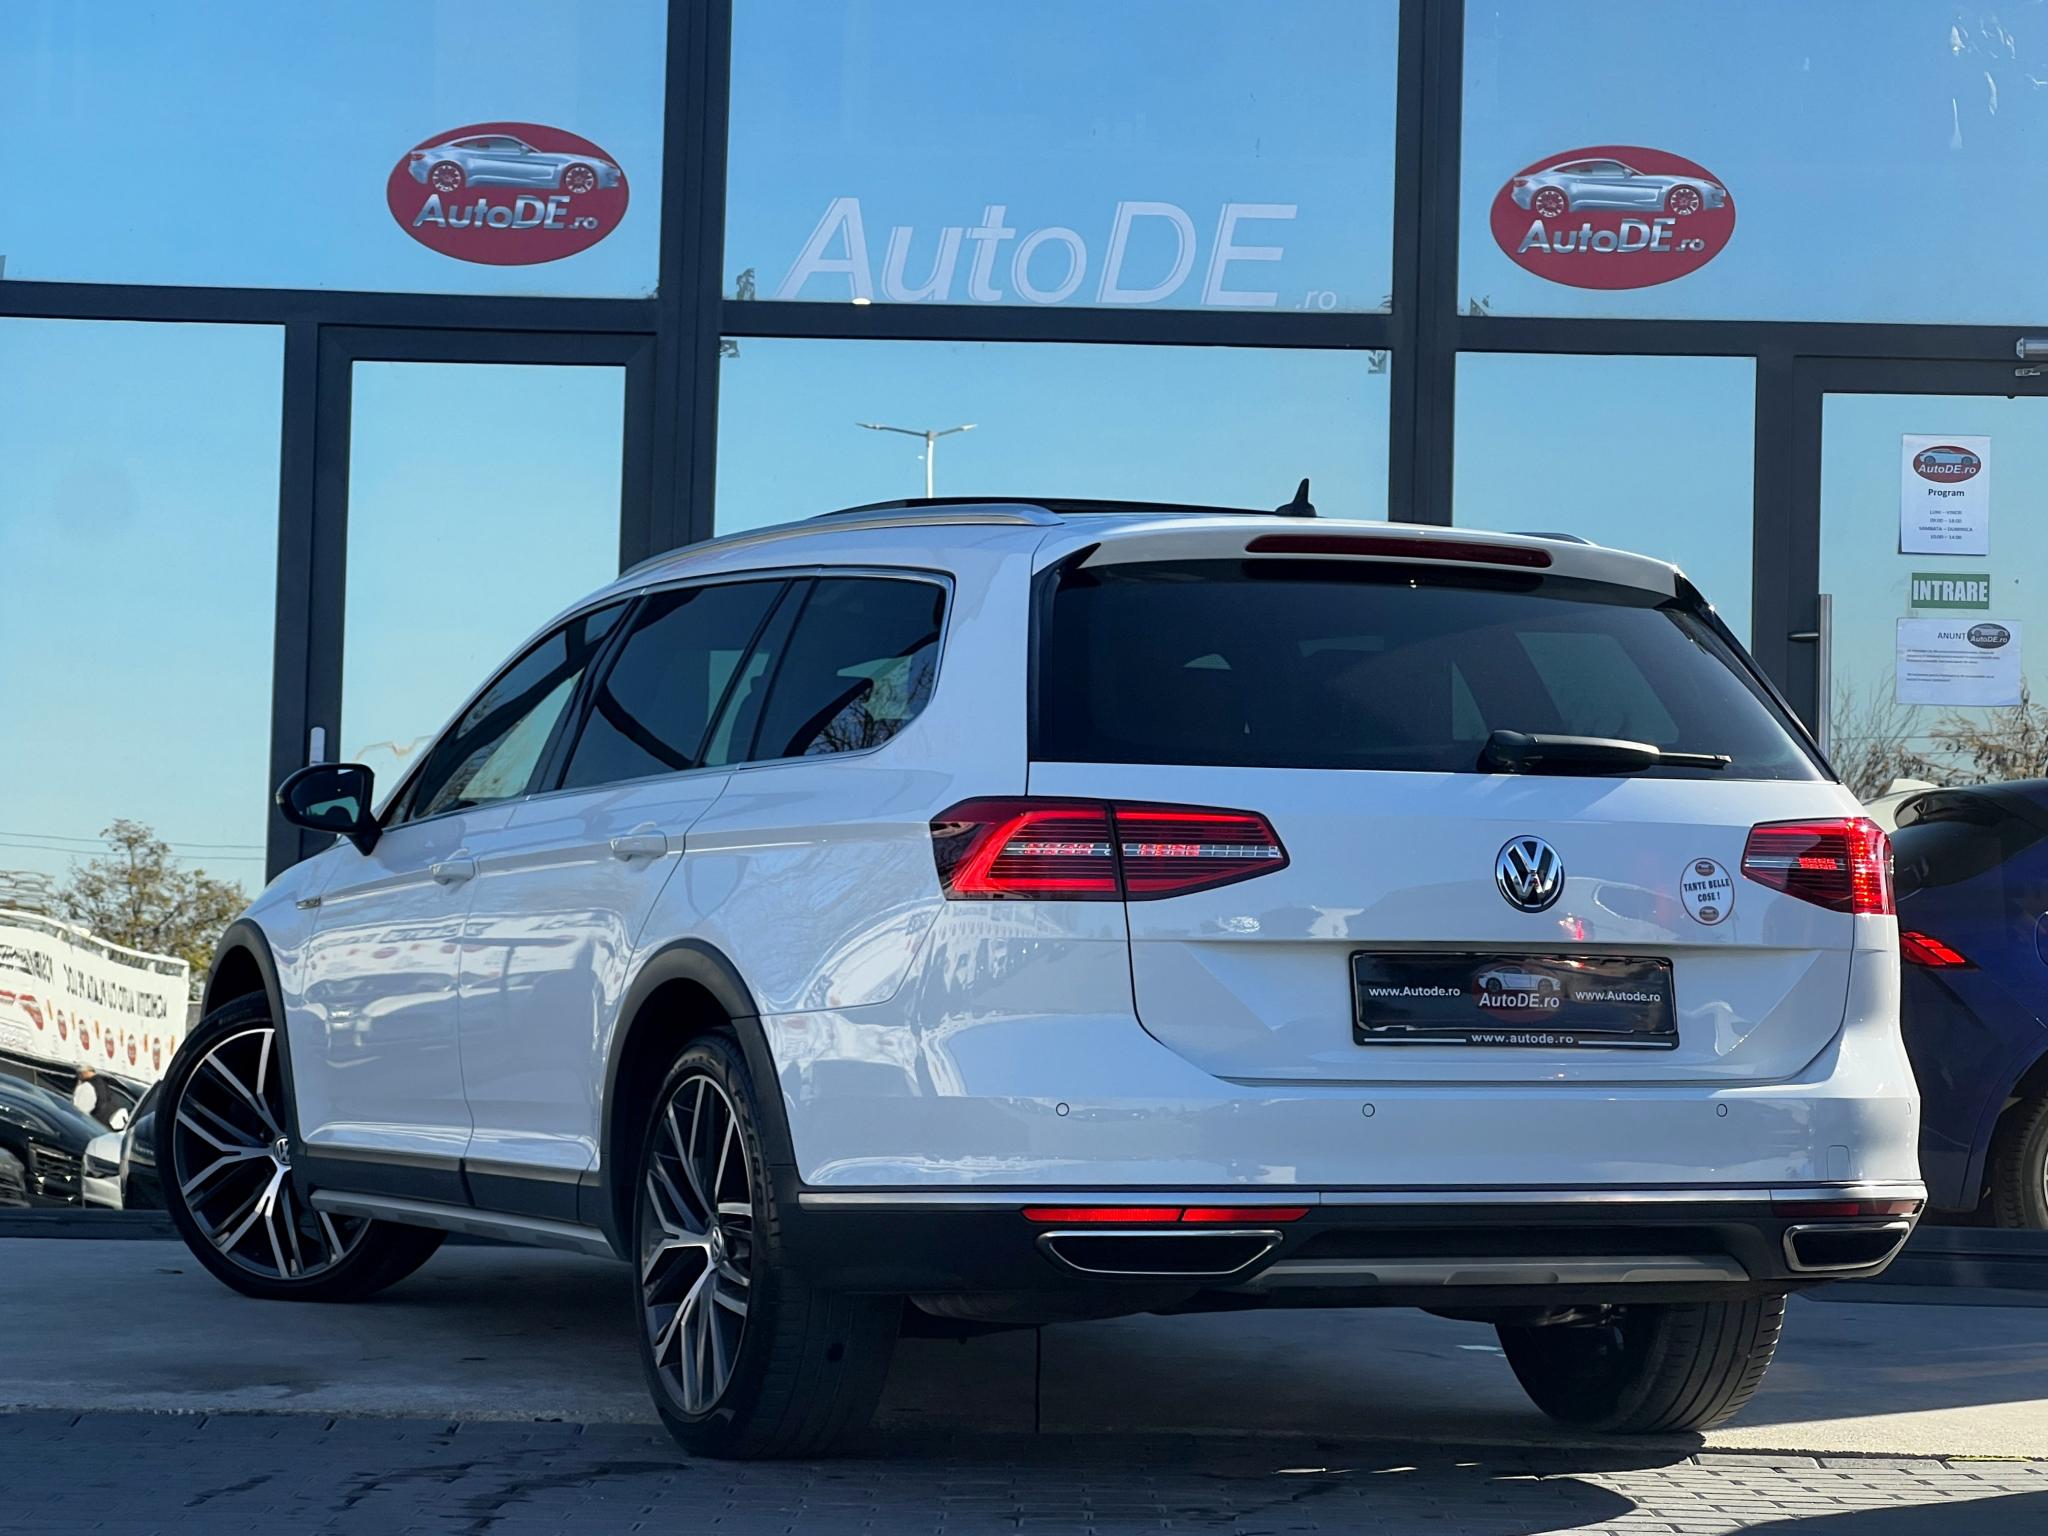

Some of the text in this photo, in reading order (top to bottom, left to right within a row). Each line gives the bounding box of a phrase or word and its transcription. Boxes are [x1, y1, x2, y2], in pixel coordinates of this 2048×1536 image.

[1917, 464, 1977, 475] AutoDE.ro
[1928, 488, 1965, 498] Program
[1913, 579, 1988, 603] INTRARE
[1969, 635, 2008, 643] AutoDE.ro
[1683, 878, 1730, 892] TANTE BELLE
[1697, 892, 1716, 902] COSE
[1368, 985, 1661, 1009] www.Autode.ro AutoDE.ro www.Autode.ro
[1471, 1033, 1574, 1045] www.autode.ro
